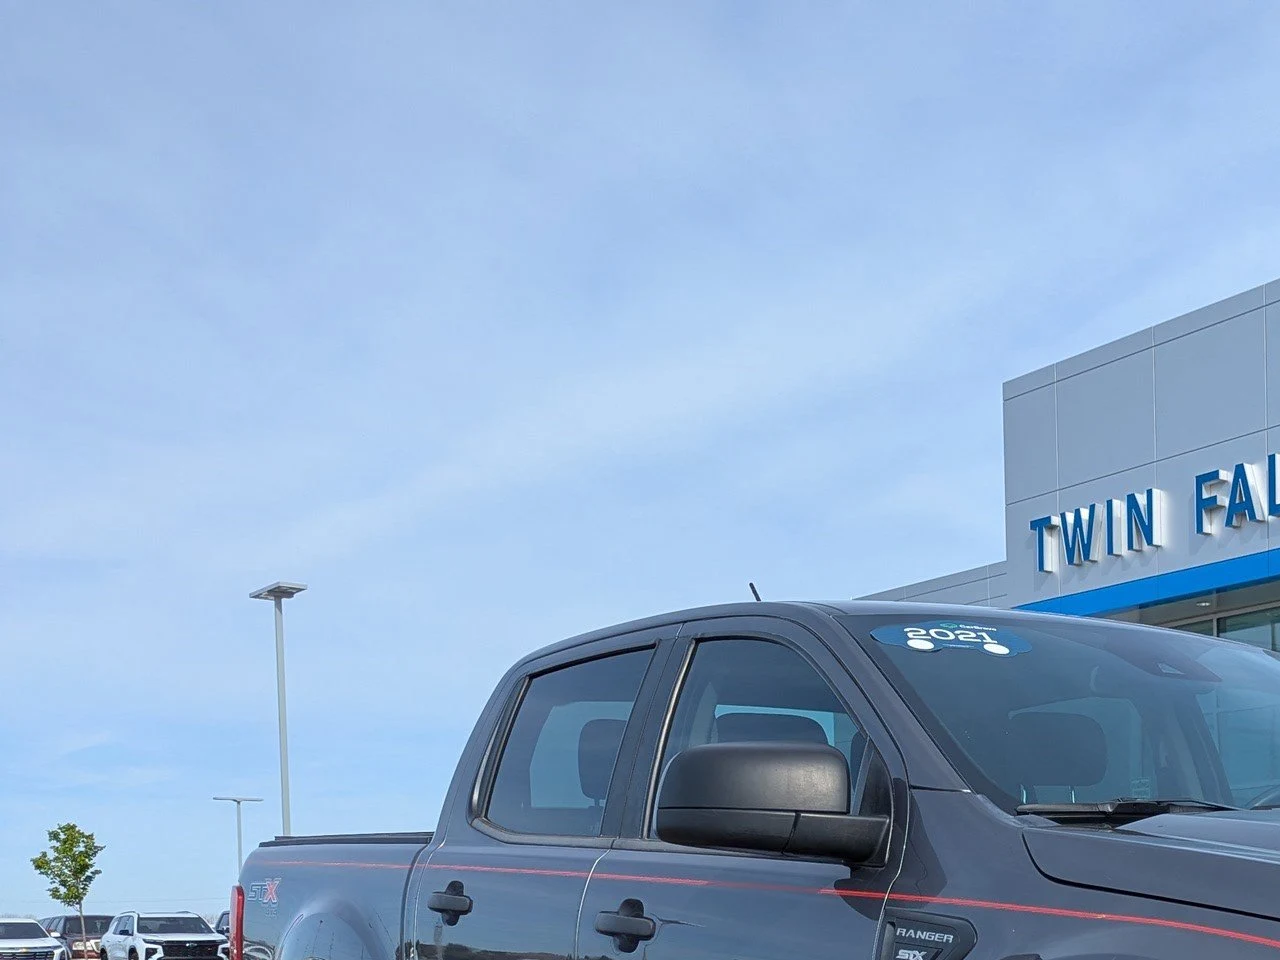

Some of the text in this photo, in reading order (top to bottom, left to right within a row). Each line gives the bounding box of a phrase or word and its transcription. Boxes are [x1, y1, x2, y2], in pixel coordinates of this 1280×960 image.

[1030, 488, 1161, 572] TWIN
[903, 627, 998, 644] 2021
[248, 878, 281, 903] STX
[896, 927, 954, 943] RANGER
